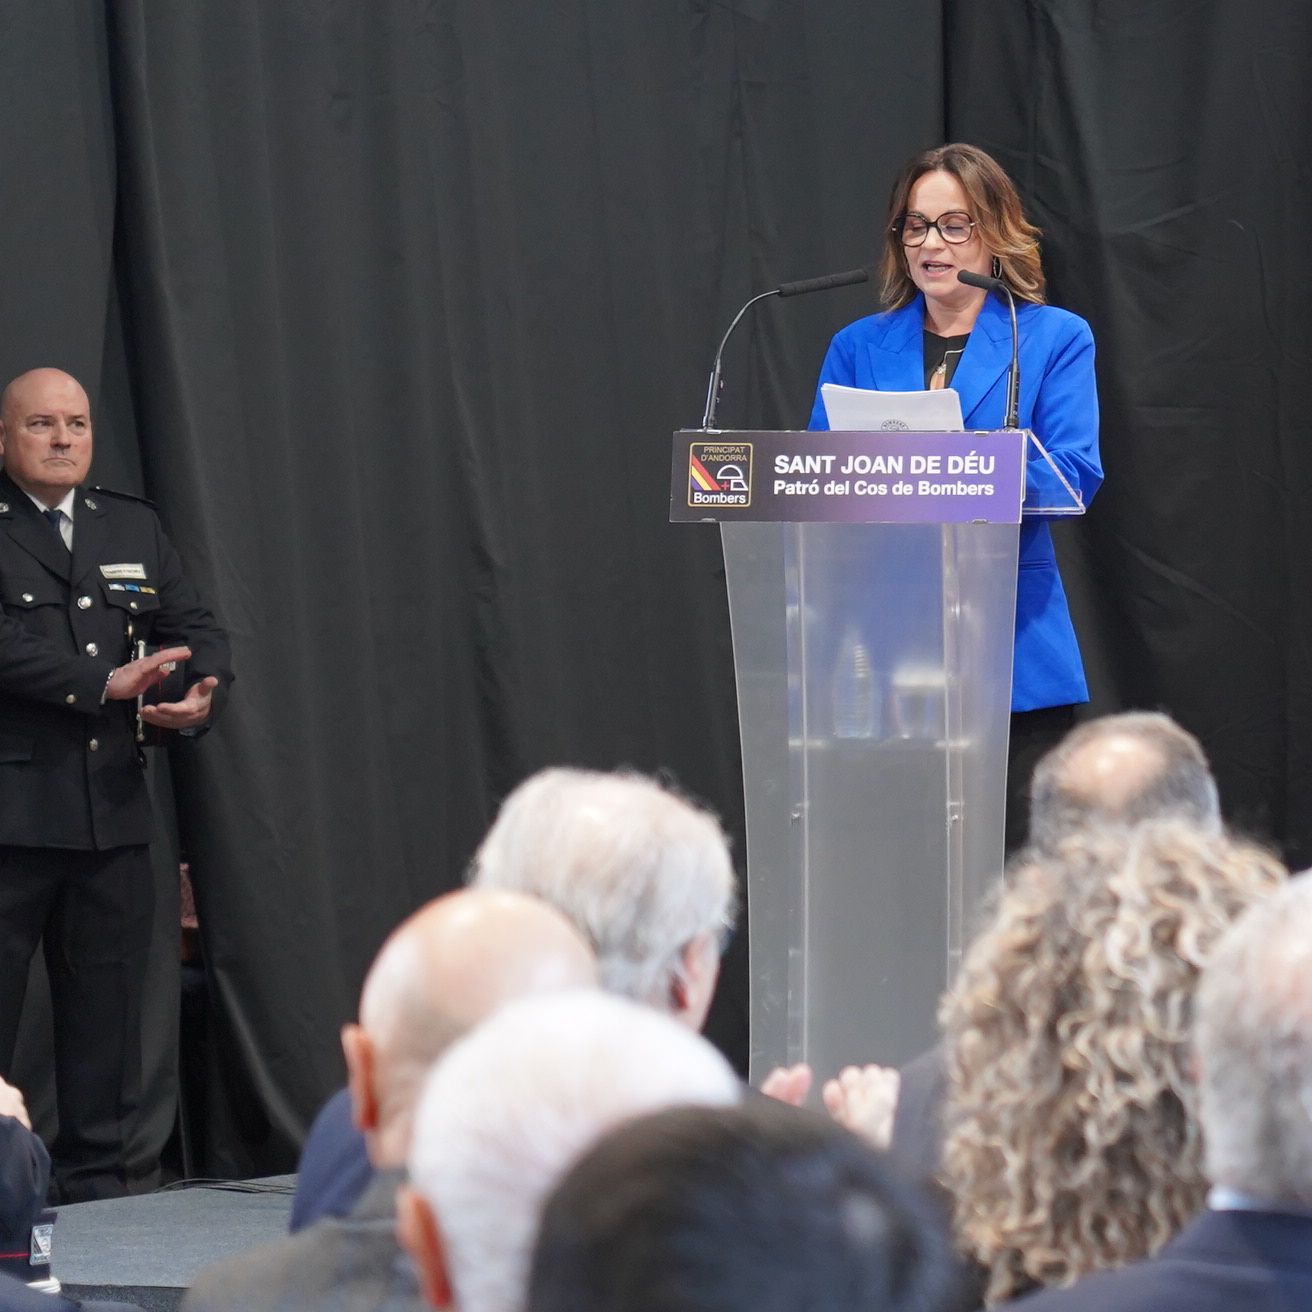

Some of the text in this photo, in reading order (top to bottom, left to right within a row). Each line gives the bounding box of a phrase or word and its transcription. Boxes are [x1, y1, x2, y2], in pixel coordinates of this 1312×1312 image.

[703, 446, 746, 454] PRINCIPAT
[700, 454, 748, 462] D'ANDORRA
[774, 451, 995, 474] SANT JOAN DE DÉU
[773, 479, 995, 496] Patró del Cos de Bombers
[693, 492, 746, 503] Bombers
